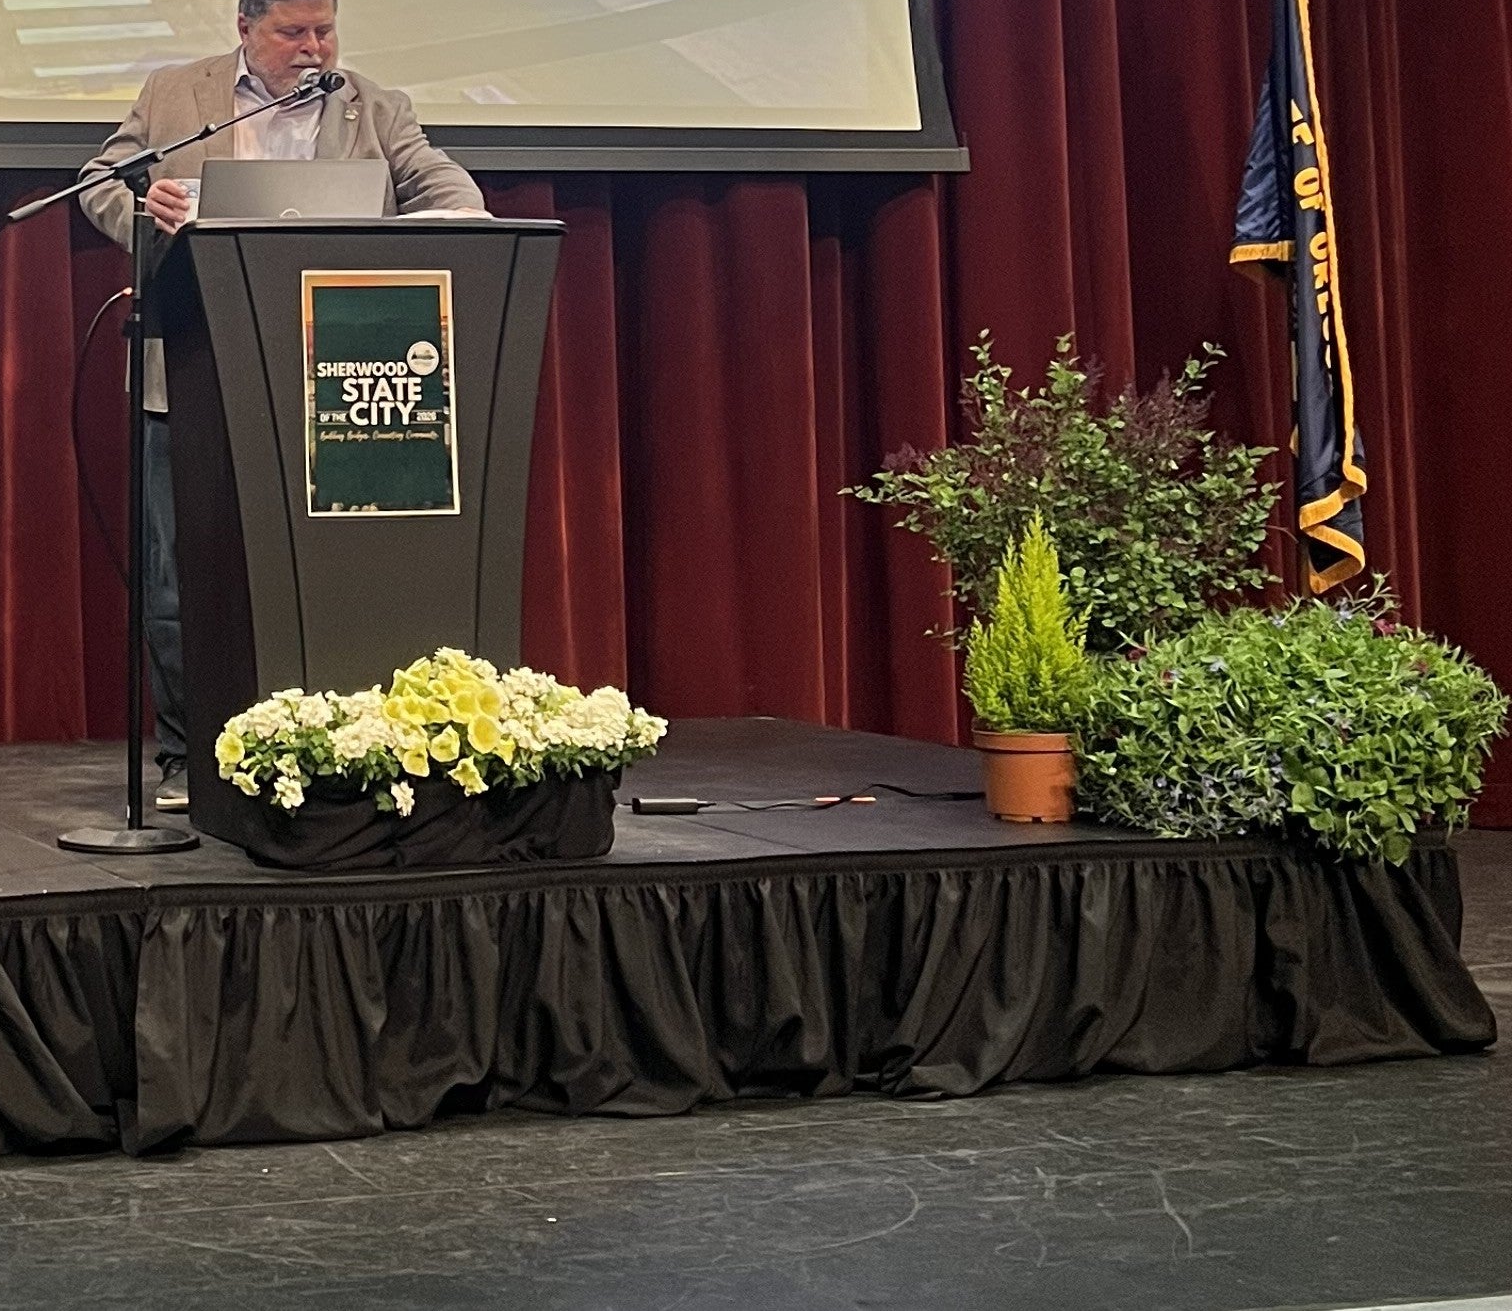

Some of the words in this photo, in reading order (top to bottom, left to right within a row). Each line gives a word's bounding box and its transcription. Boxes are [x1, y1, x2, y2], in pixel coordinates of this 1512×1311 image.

[317, 361, 408, 378] SHERWOOD
[342, 377, 423, 402] STATE
[349, 401, 416, 426] CITY
